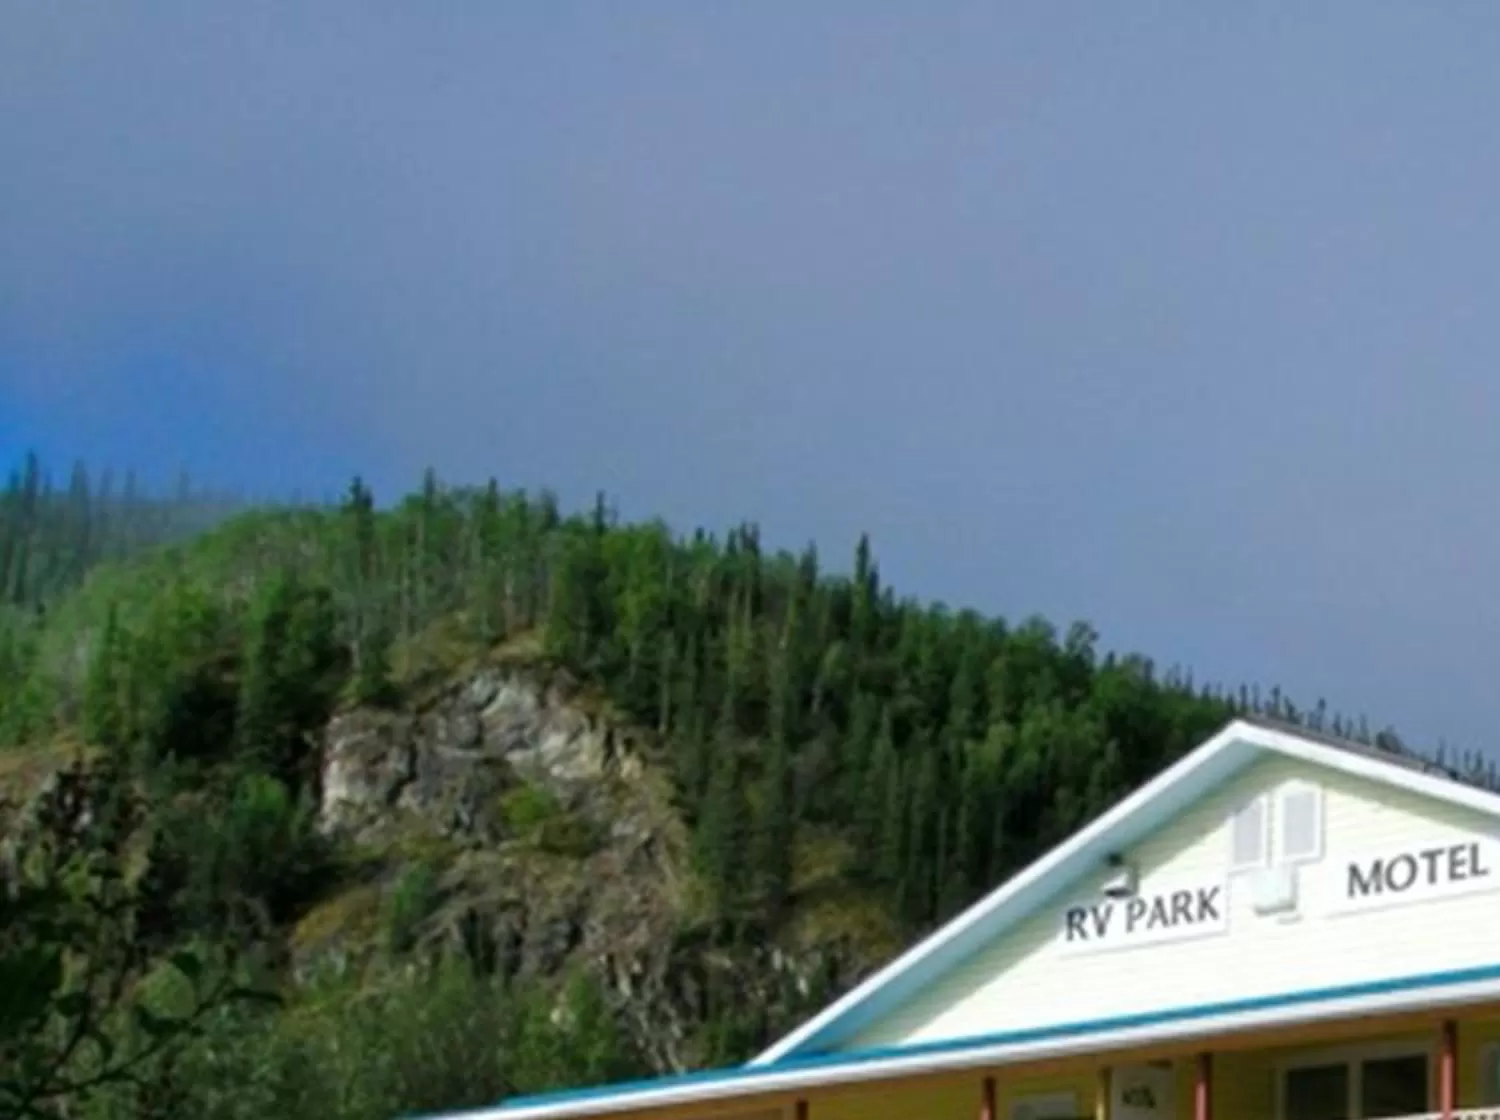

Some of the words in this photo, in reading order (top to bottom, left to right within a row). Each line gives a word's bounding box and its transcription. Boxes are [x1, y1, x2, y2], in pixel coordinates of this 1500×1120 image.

[1347, 842, 1490, 899] MOTEL
[1066, 904, 1113, 941] RV
[1126, 886, 1220, 933] PARK
